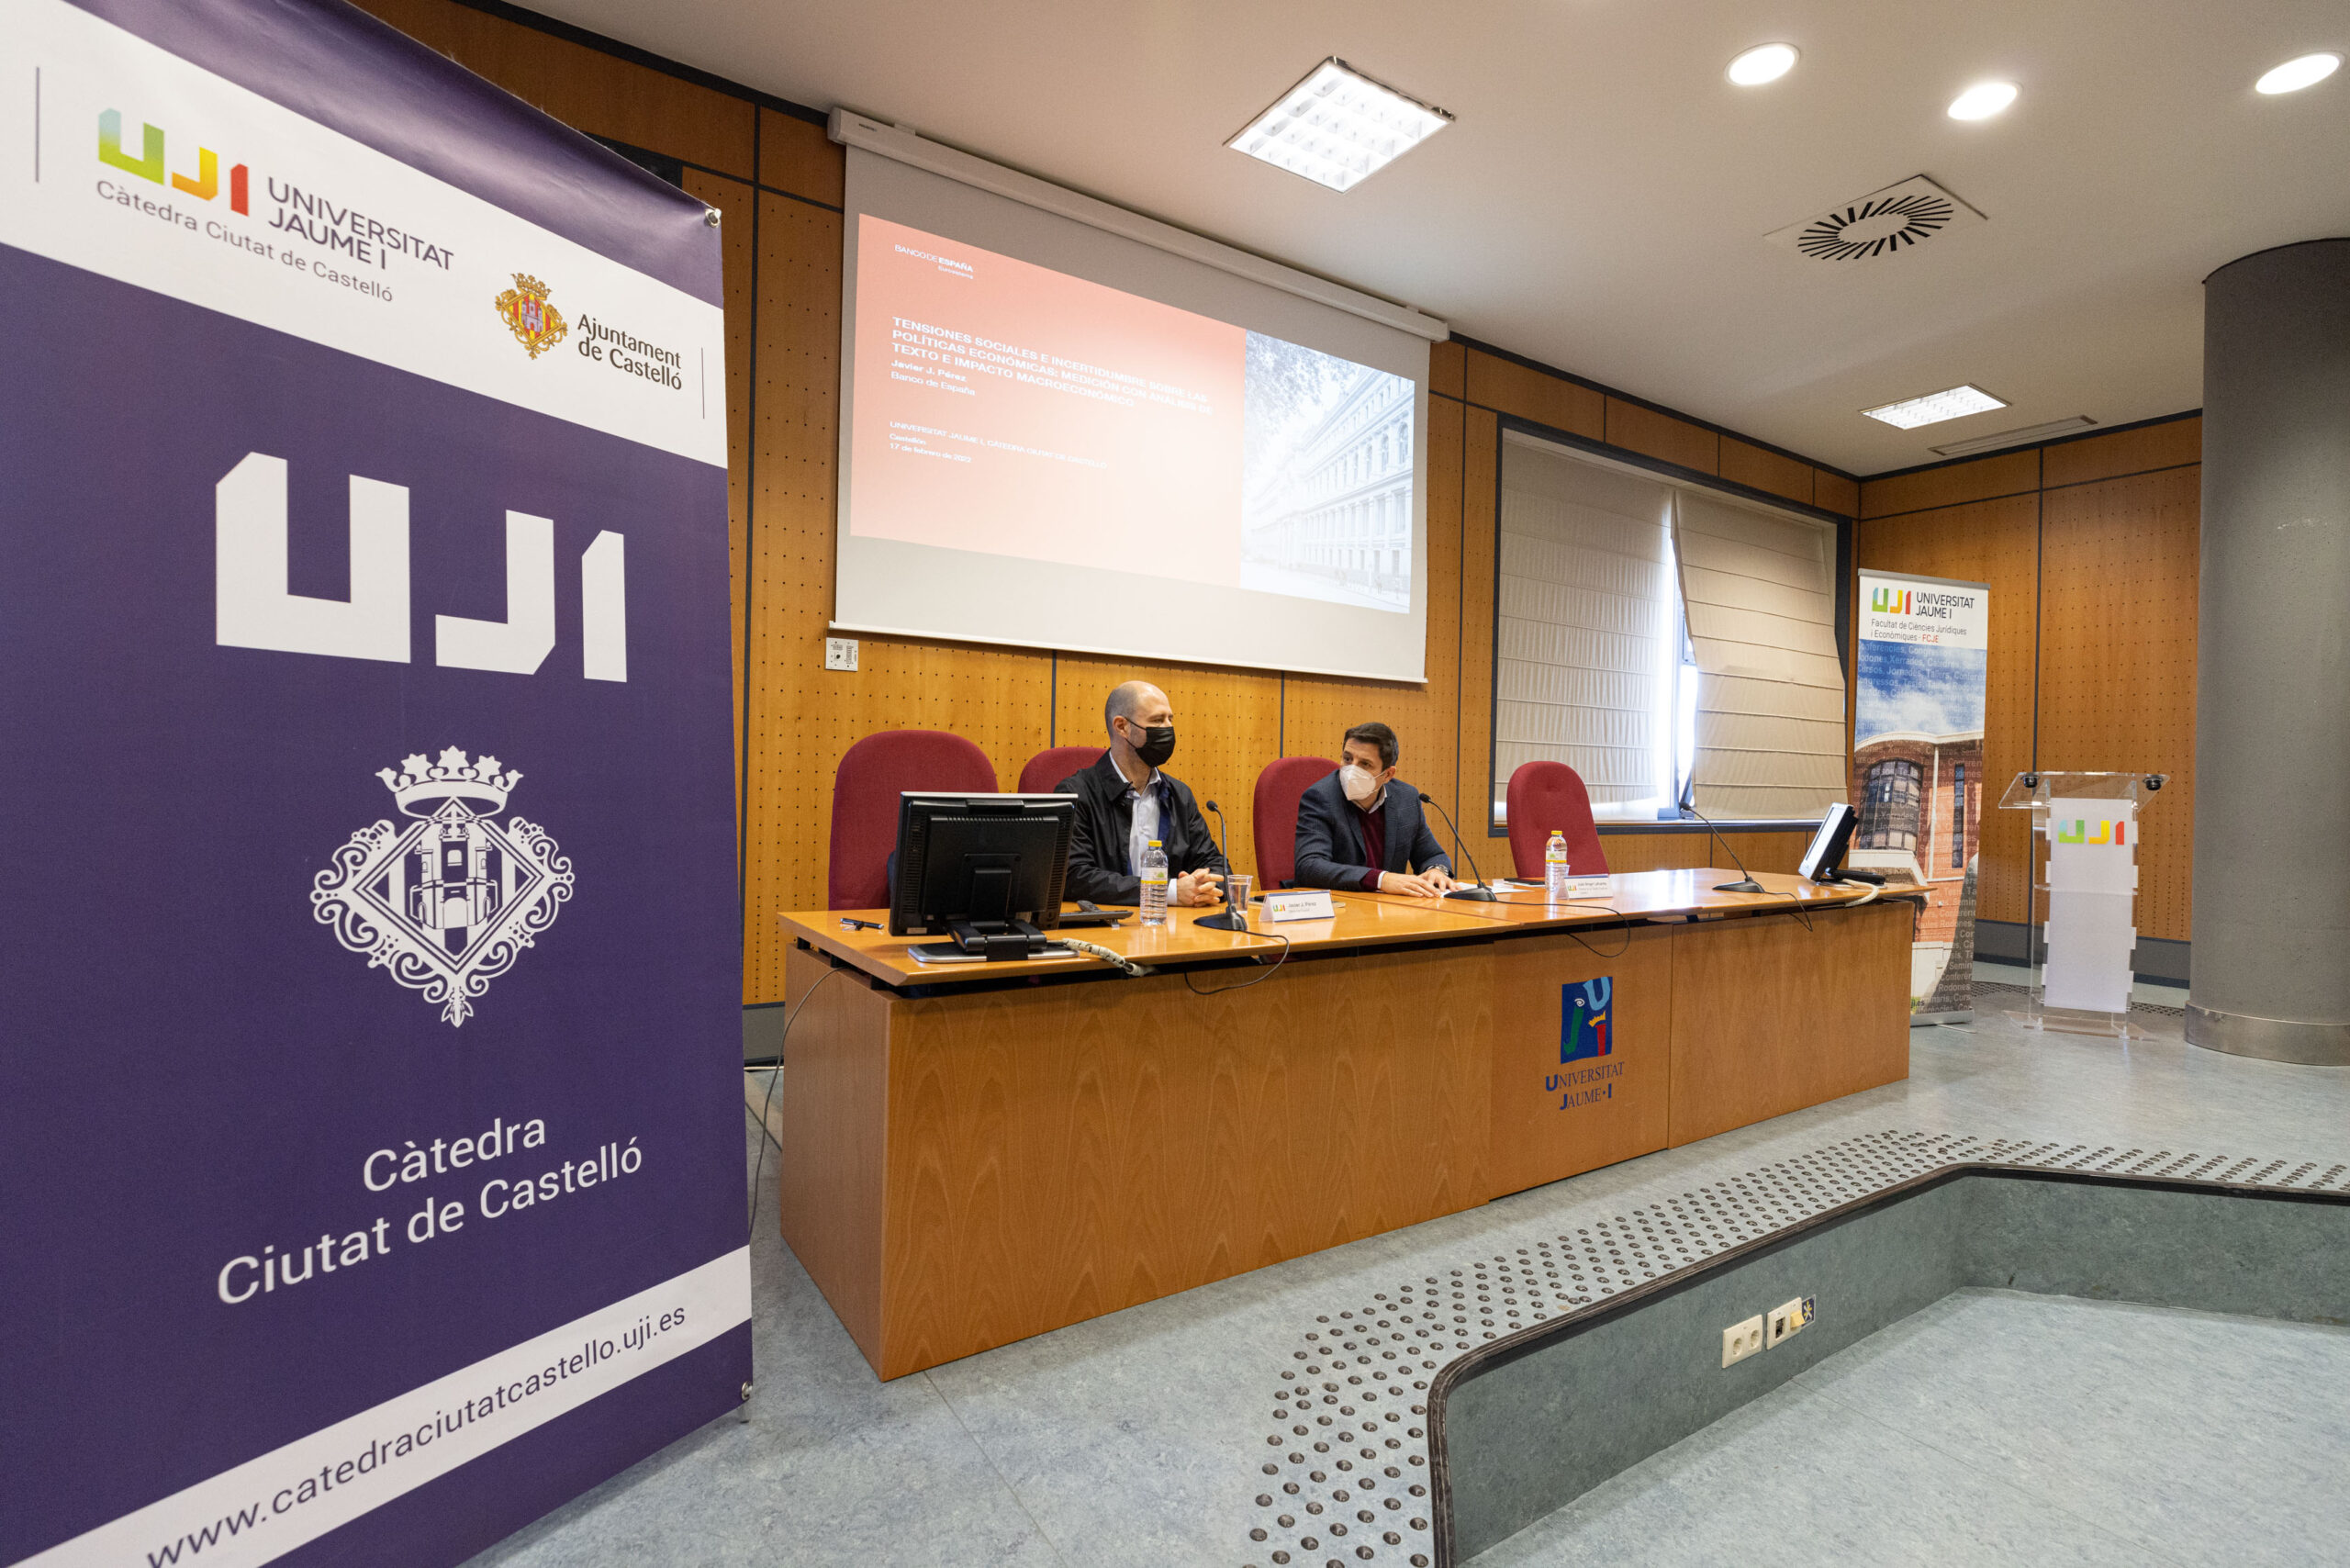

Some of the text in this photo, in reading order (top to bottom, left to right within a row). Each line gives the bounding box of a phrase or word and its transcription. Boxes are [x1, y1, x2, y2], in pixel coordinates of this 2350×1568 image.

[96, 180, 394, 302] Càtedra Ciutat de Castelló
[268, 176, 453, 270] UNIVERSITAT
[268, 207, 386, 270] JAUME I
[577, 313, 681, 369] Ajuntament
[578, 336, 682, 390] de Castelló
[891, 342, 939, 361] TEXTO
[942, 353, 952, 364] E
[954, 356, 1013, 379] IMPACTO
[891, 329, 966, 354] POLÍTICAS
[968, 347, 1058, 378] ECONÓMICAS:
[1061, 369, 1120, 392] MEDICIÓN
[1122, 385, 1147, 399] CON
[892, 316, 972, 344] TENSIONES
[975, 337, 1038, 360] SOCIALES
[1040, 353, 1049, 364] E
[1051, 355, 1147, 388] INCERTIDUMBRE
[890, 359, 967, 382] Javier J. Pérez
[890, 370, 976, 397] Banco de España
[901, 444, 912, 453] de
[216, 451, 628, 683] UJI
[1871, 618, 1897, 629] Facultat
[1898, 621, 1908, 630] de
[1872, 587, 1911, 615] UJI
[1916, 591, 1975, 609] UNIVERSITAT
[1916, 605, 1947, 620] JAUME
[1921, 633, 1940, 644] FCJE
[1545, 1061, 1625, 1092] UNIVERSITAT
[363, 1116, 548, 1193] Càtedra
[218, 1136, 643, 1305] Ciutat de Castelló
[147, 1305, 687, 1568] www.catedraciutatcastello.uji.es
